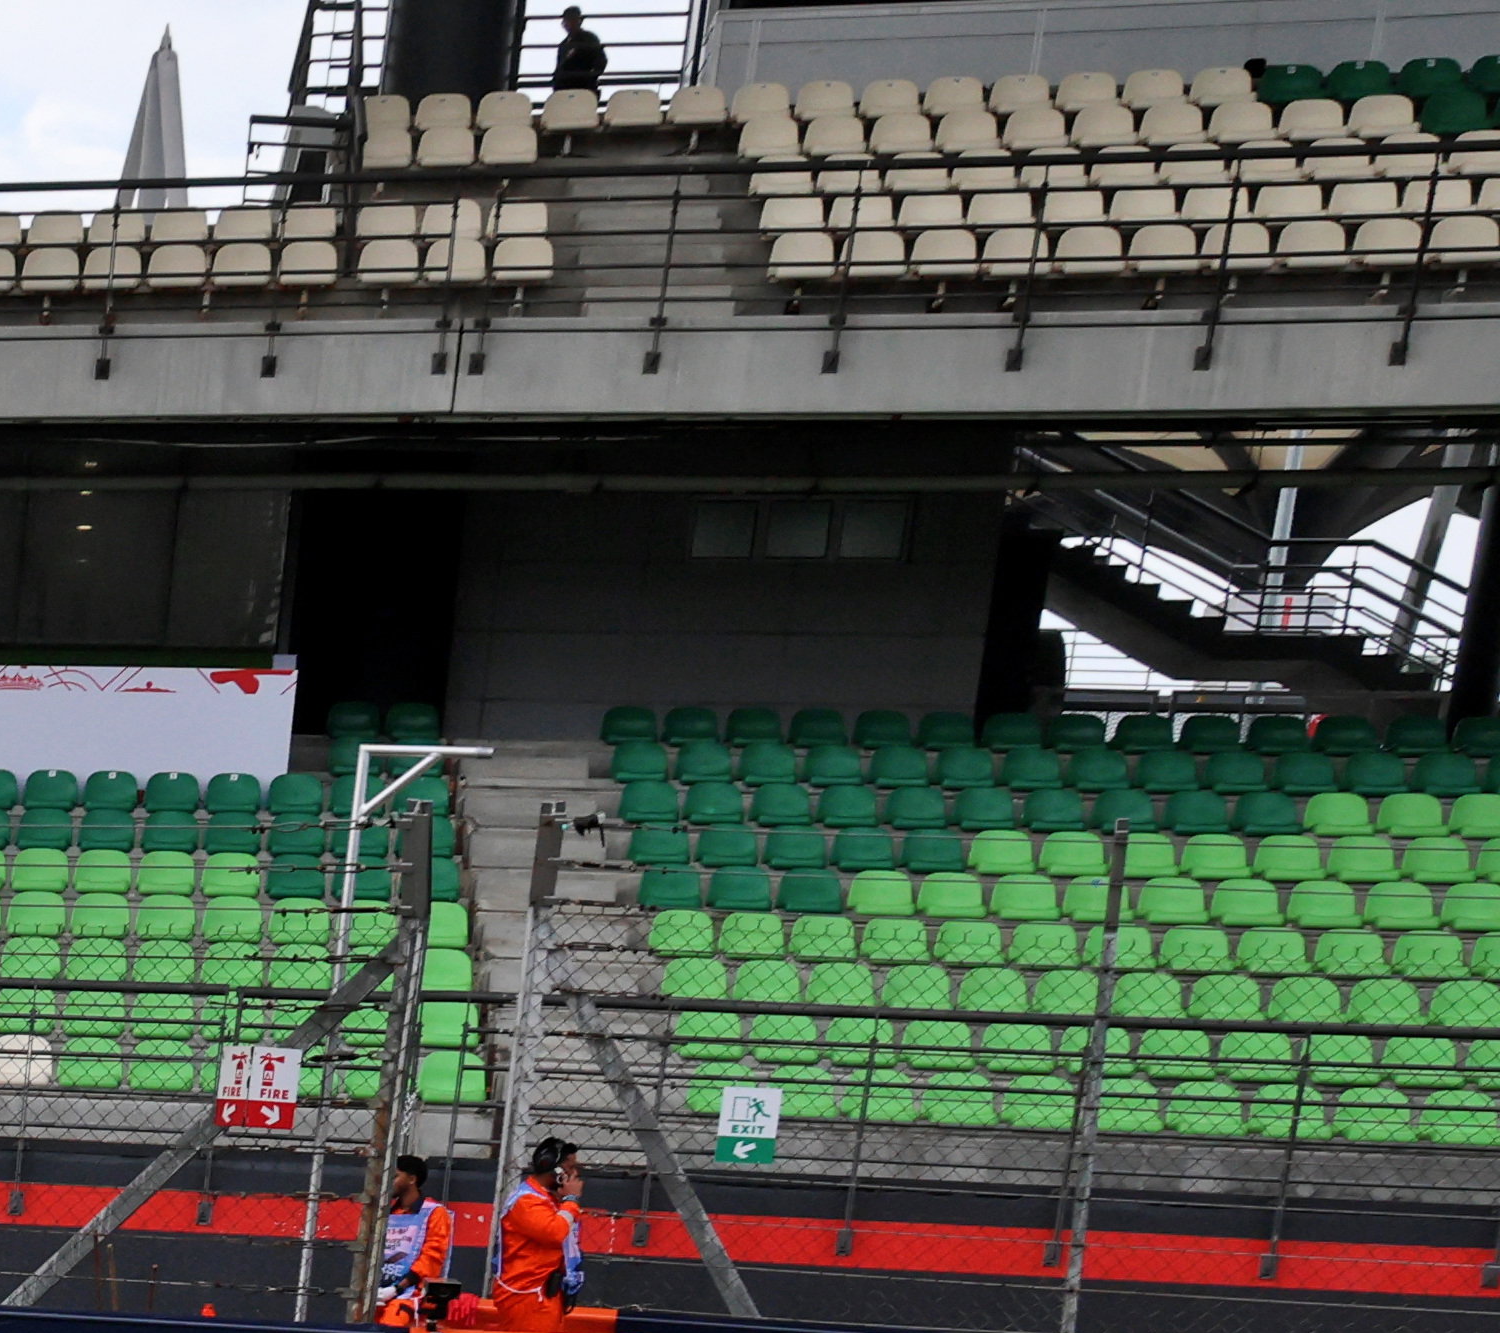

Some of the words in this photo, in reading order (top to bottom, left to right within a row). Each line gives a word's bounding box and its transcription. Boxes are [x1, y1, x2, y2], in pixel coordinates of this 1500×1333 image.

[222, 1086, 242, 1097] FIRE
[260, 1088, 289, 1100] FIRE
[731, 1124, 766, 1135] EXIT
